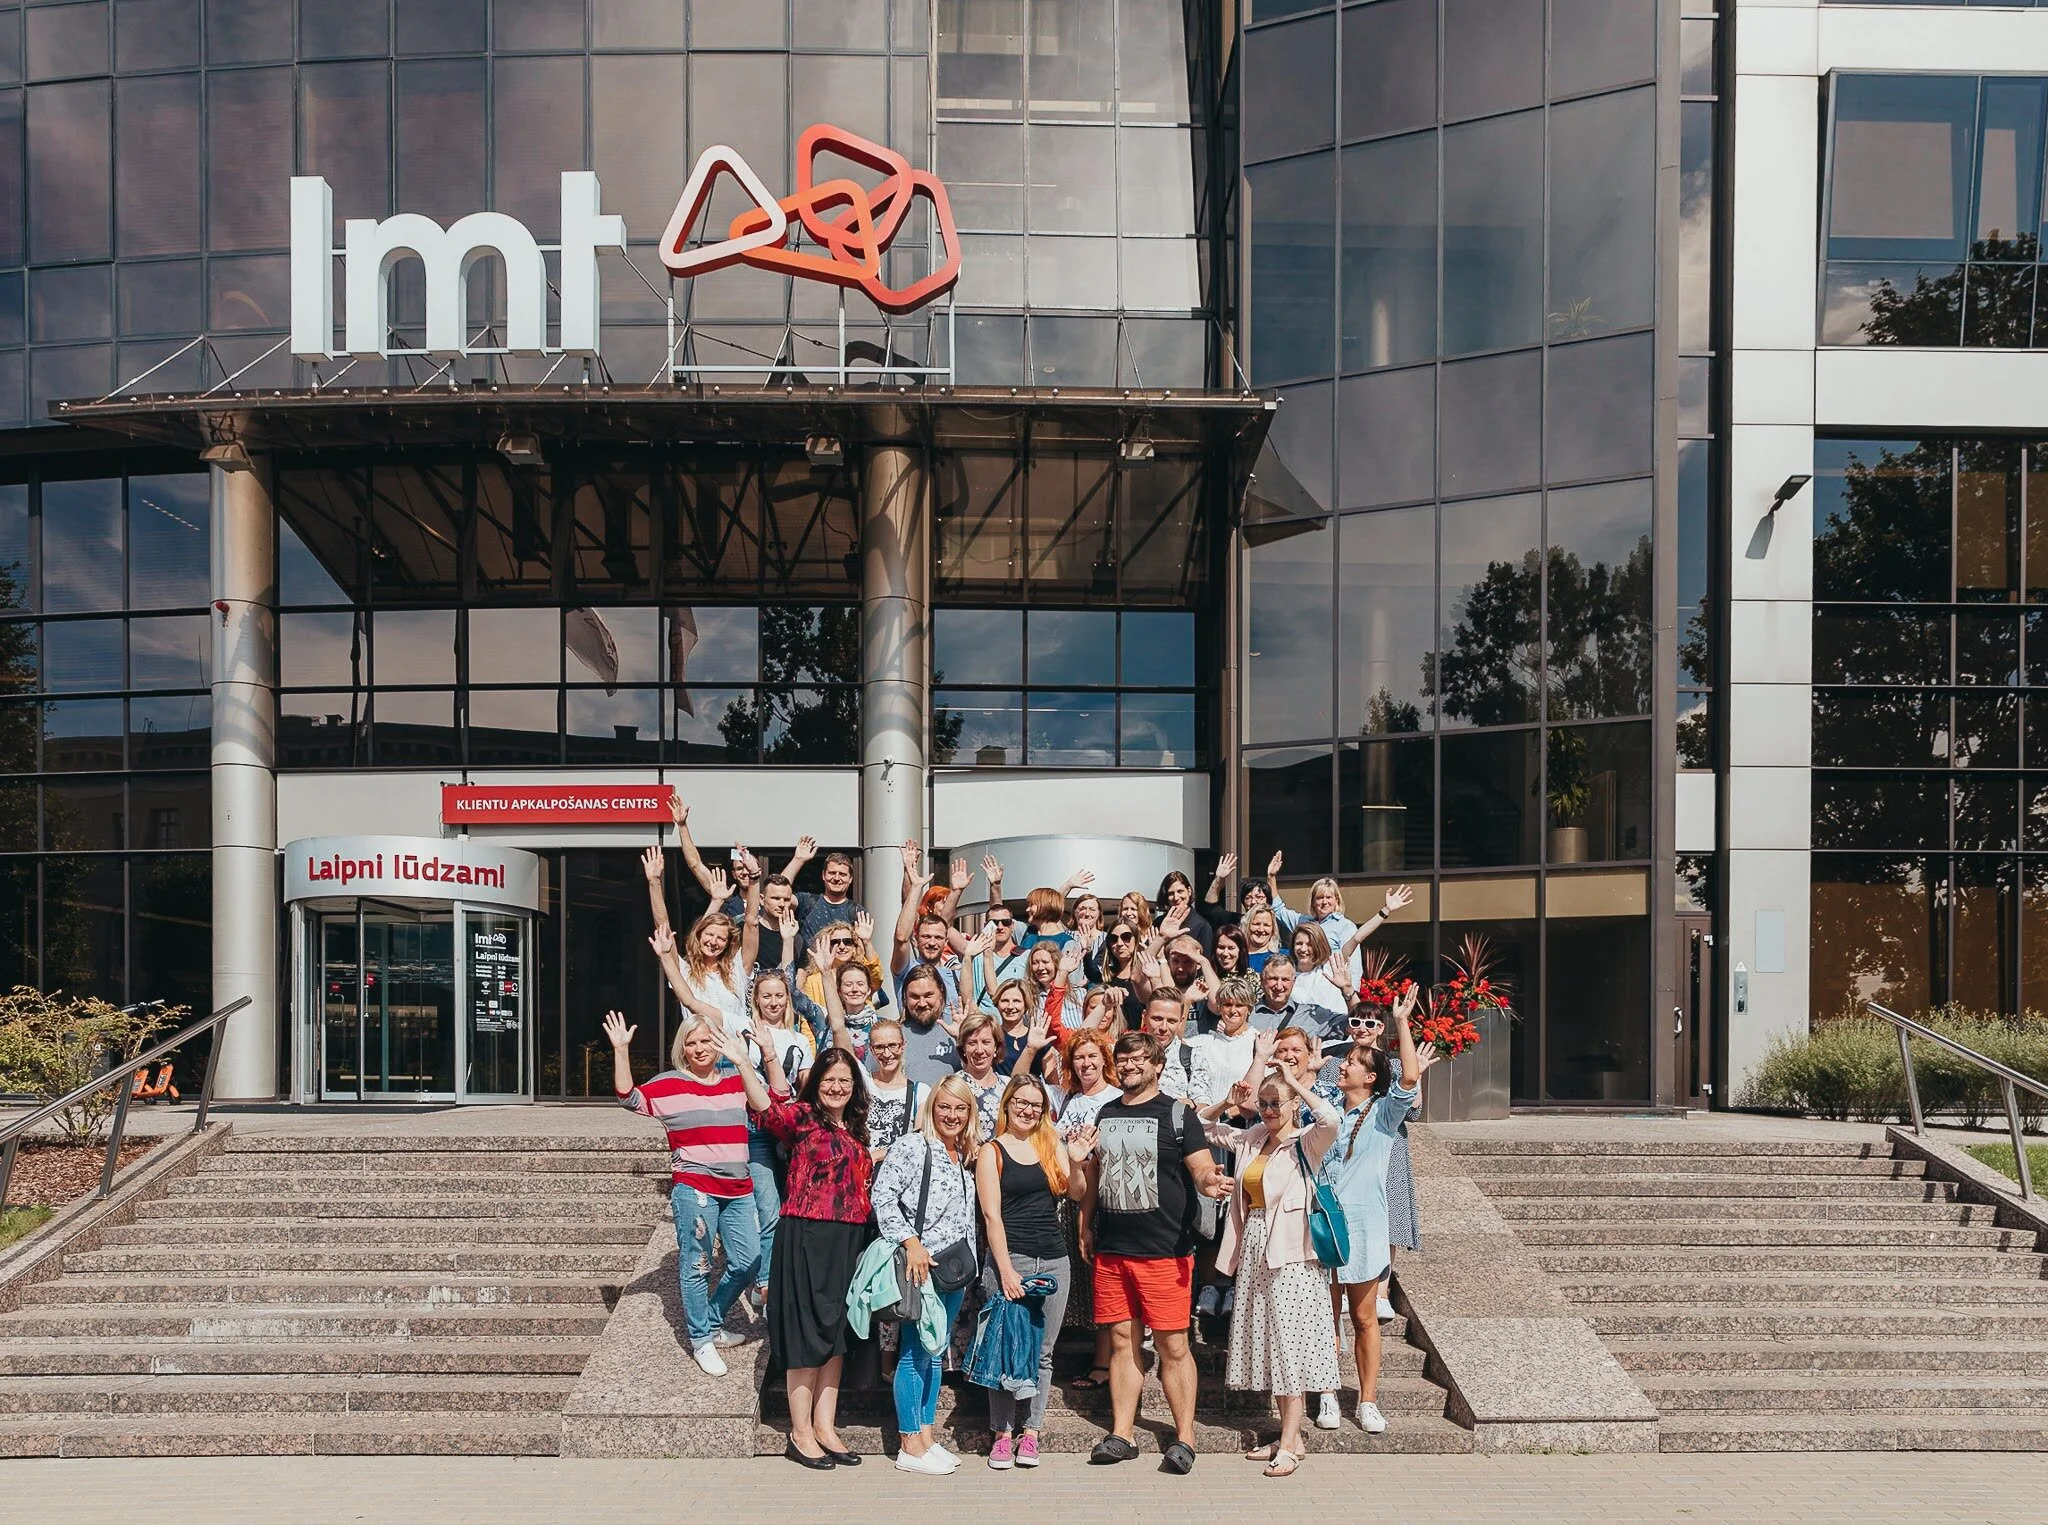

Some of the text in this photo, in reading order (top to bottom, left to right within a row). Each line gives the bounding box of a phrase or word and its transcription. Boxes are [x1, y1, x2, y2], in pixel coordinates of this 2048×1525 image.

[290, 170, 627, 361] lmt
[456, 796, 659, 811] KLIENTU APKALPOŠANAS CENTRS
[308, 853, 505, 889] Laipni lūdzam!
